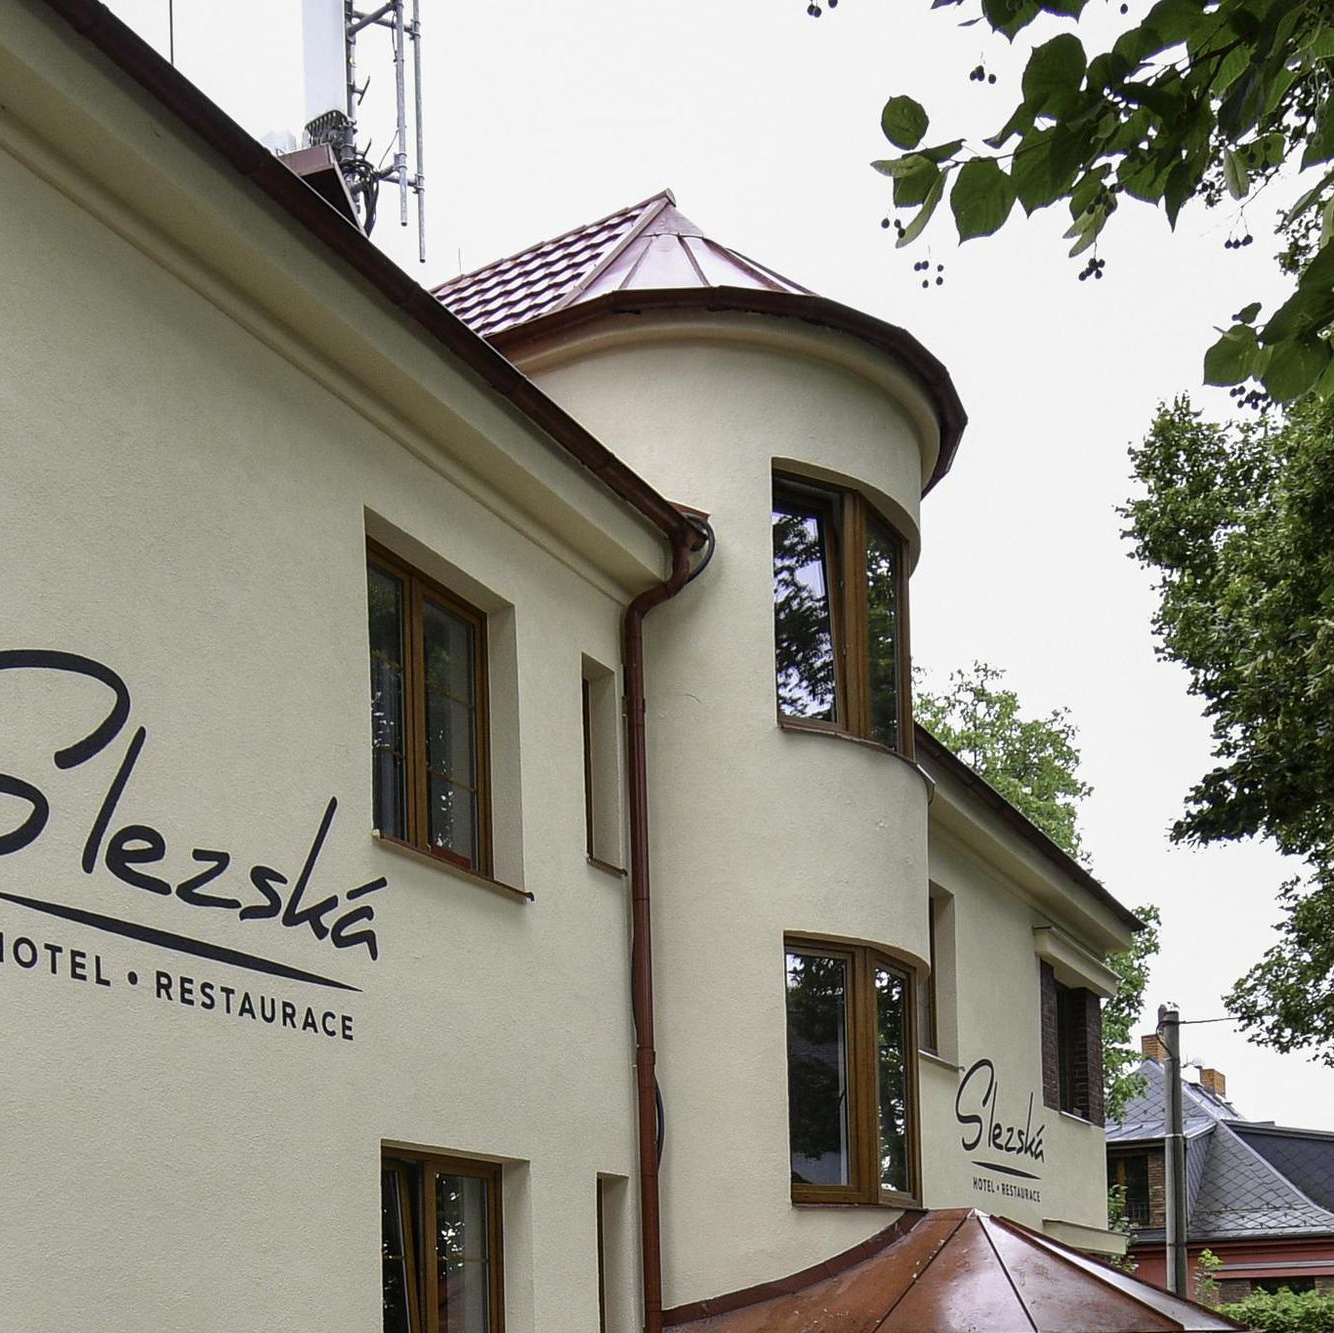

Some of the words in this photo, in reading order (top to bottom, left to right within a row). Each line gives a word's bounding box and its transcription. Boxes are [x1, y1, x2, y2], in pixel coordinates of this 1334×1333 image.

[155, 970, 354, 1040] RESTAURACE
[956, 1059, 1045, 1163] Slezská
[973, 1176, 995, 1193] HOTEL
[1002, 1183, 1041, 1203] RESTAURACE
